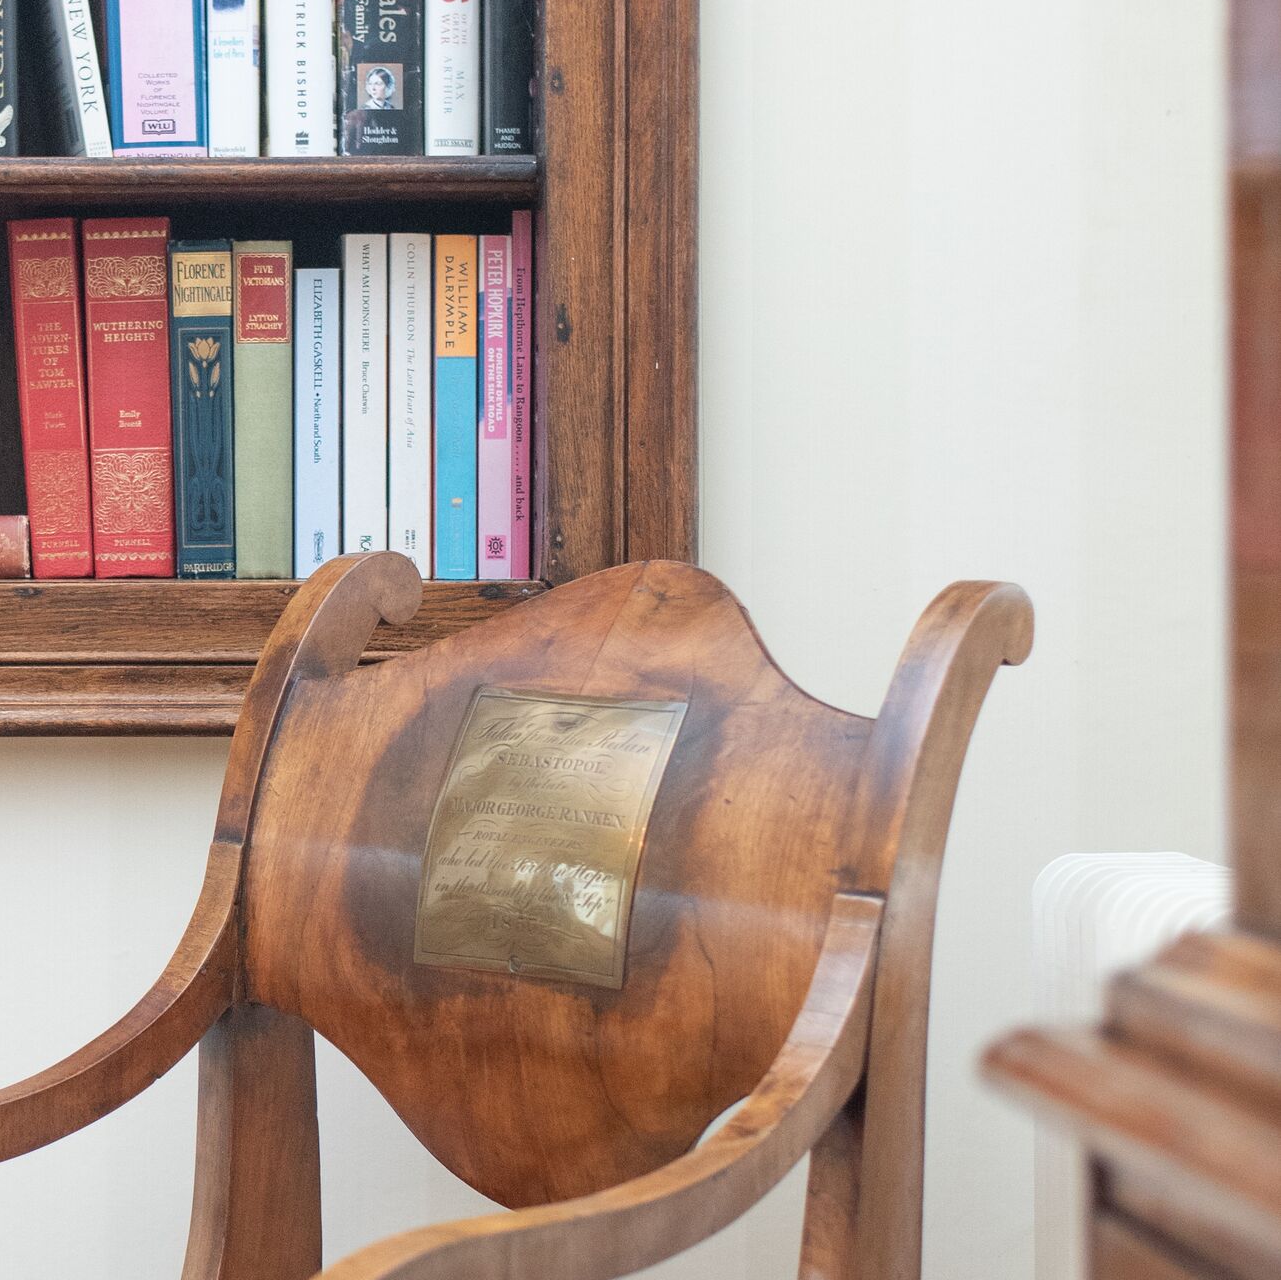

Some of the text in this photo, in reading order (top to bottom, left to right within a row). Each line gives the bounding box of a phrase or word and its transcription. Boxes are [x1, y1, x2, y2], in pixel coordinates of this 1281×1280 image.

[75, 51, 99, 114] YORK
[296, 60, 307, 119] BISHOP
[175, 261, 227, 284] FLORENCE
[253, 265, 274, 274] FIVE
[242, 276, 285, 287] VICTORIANS
[407, 242, 416, 342] COLIN THUBRON
[174, 284, 232, 307] NIGHTINGALE
[444, 255, 456, 349] DALRYMPLE
[458, 262, 469, 335] WILLIAM
[487, 250, 504, 339] PETER HOPKIRK
[37, 322, 63, 333] THE
[93, 320, 164, 331] WUTHERING
[245, 322, 283, 331] STRACHEY
[248, 314, 279, 322] LYTTON
[103, 332, 156, 343] HEIGHTS
[313, 278, 323, 389] ELIZABETH GASKELL
[31, 345, 70, 356] TURES
[38, 368, 65, 378] TOM
[43, 358, 59, 366] OF
[29, 378, 76, 390] SAWYER
[361, 361, 370, 415] Bruce Chatwin
[487, 348, 495, 432] ON THE SILK ROAD
[495, 347, 503, 421] FOREIGN DEVILS
[514, 268, 525, 522] From Hepthorne Lane to Rangoon and back
[118, 410, 141, 419] Emily
[313, 398, 321, 464] North and South
[113, 538, 151, 547] PURNELL
[183, 561, 235, 573] PARTRIDGE
[497, 799, 556, 821] GEORGE
